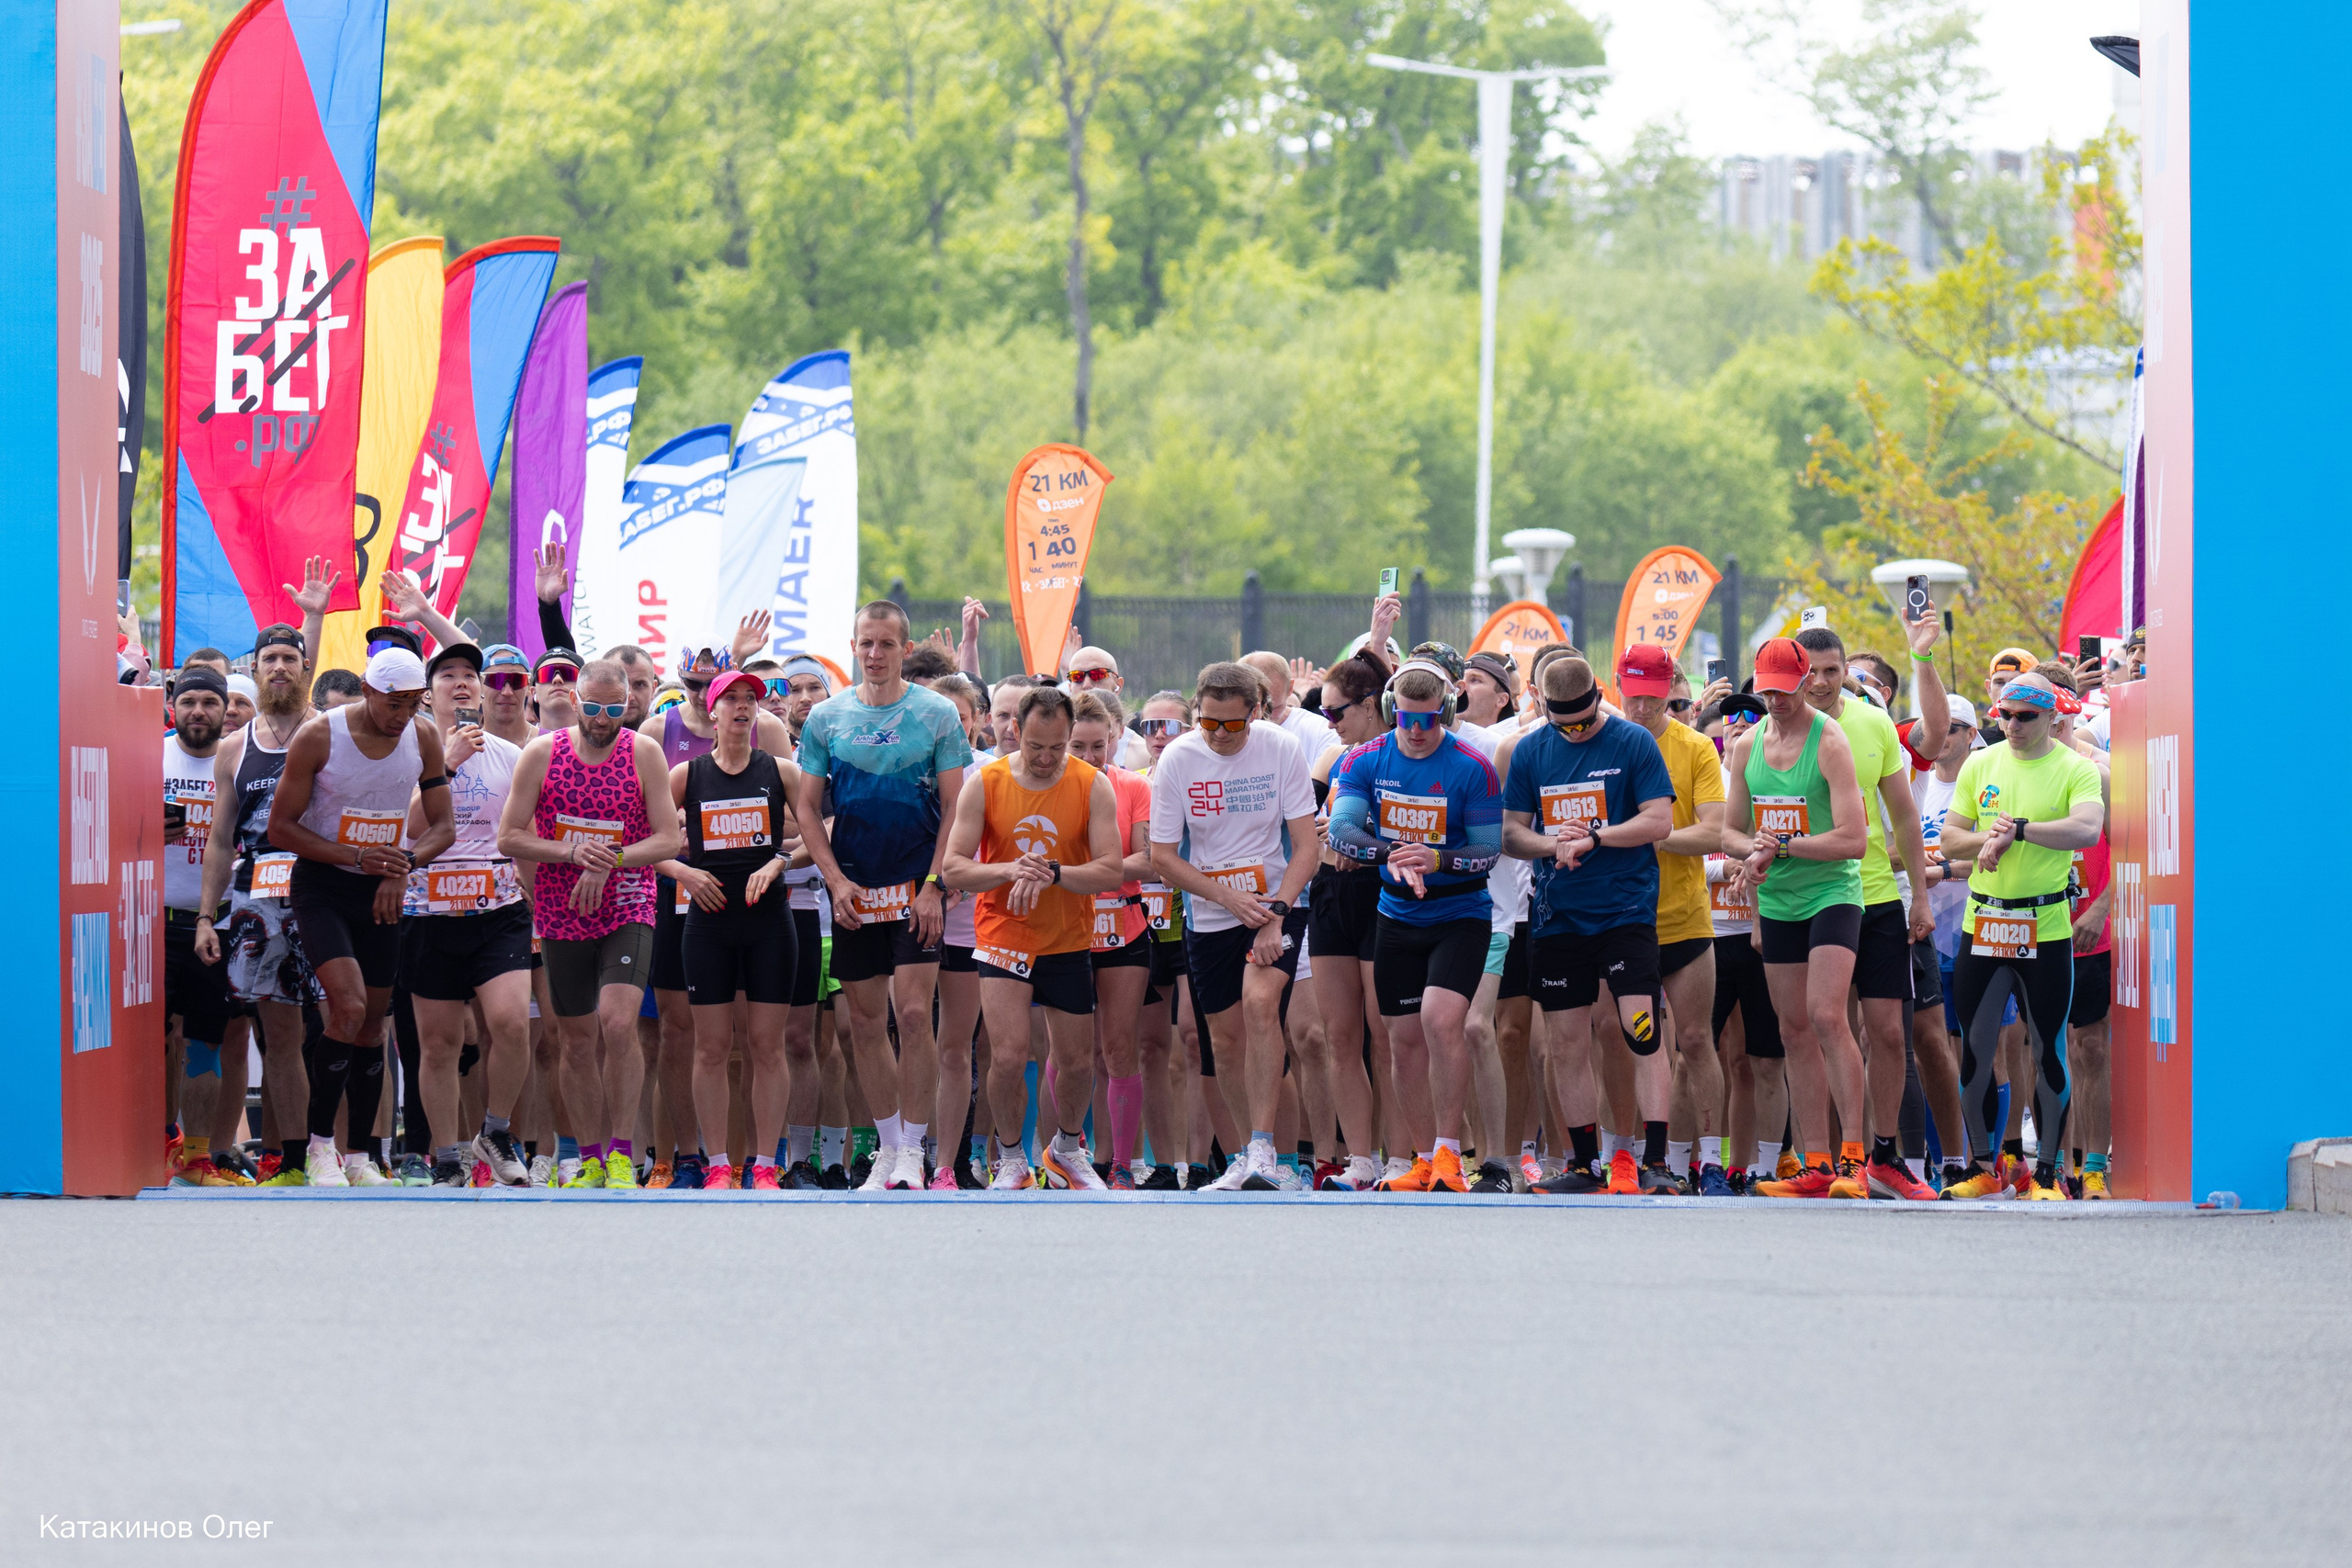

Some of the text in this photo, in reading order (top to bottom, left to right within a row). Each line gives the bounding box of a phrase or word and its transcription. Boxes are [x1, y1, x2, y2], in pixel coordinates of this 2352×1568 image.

[235, 227, 332, 321] ЗА
[81, 231, 103, 378] 2025
[215, 315, 349, 413] БЕГ
[1030, 474, 1051, 492] 21
[620, 478, 726, 544] АБЕГ.РФ
[1040, 524, 1070, 536] 4:45
[1028, 536, 1077, 560] 1 40
[1051, 561, 1078, 570] МИНУТ
[1653, 570, 1670, 584] 21
[1504, 621, 1521, 637] 21
[1655, 625, 1678, 641] 45
[1224, 773, 1275, 788] CHINA COAST
[1588, 768, 1622, 778] FESCO
[245, 777, 277, 792] KEEP
[1188, 781, 1224, 799] 20
[1224, 783, 1270, 795] MARATHON
[1191, 799, 1225, 818] 24
[1552, 795, 1598, 821] 40513
[709, 811, 763, 835] 40050
[1387, 806, 1438, 830] 40387
[1592, 818, 1601, 828] A
[1761, 809, 1801, 830] 40271
[345, 821, 397, 844] 40560
[1430, 832, 1439, 841] B
[435, 874, 487, 897] 40237
[1211, 871, 1258, 894] 0105
[860, 886, 910, 909] 40344
[1155, 918, 1163, 926] A
[1109, 935, 1117, 944] A
[1980, 921, 2030, 945] 40020
[2018, 946, 2028, 955] A
[1017, 963, 1026, 972] A
